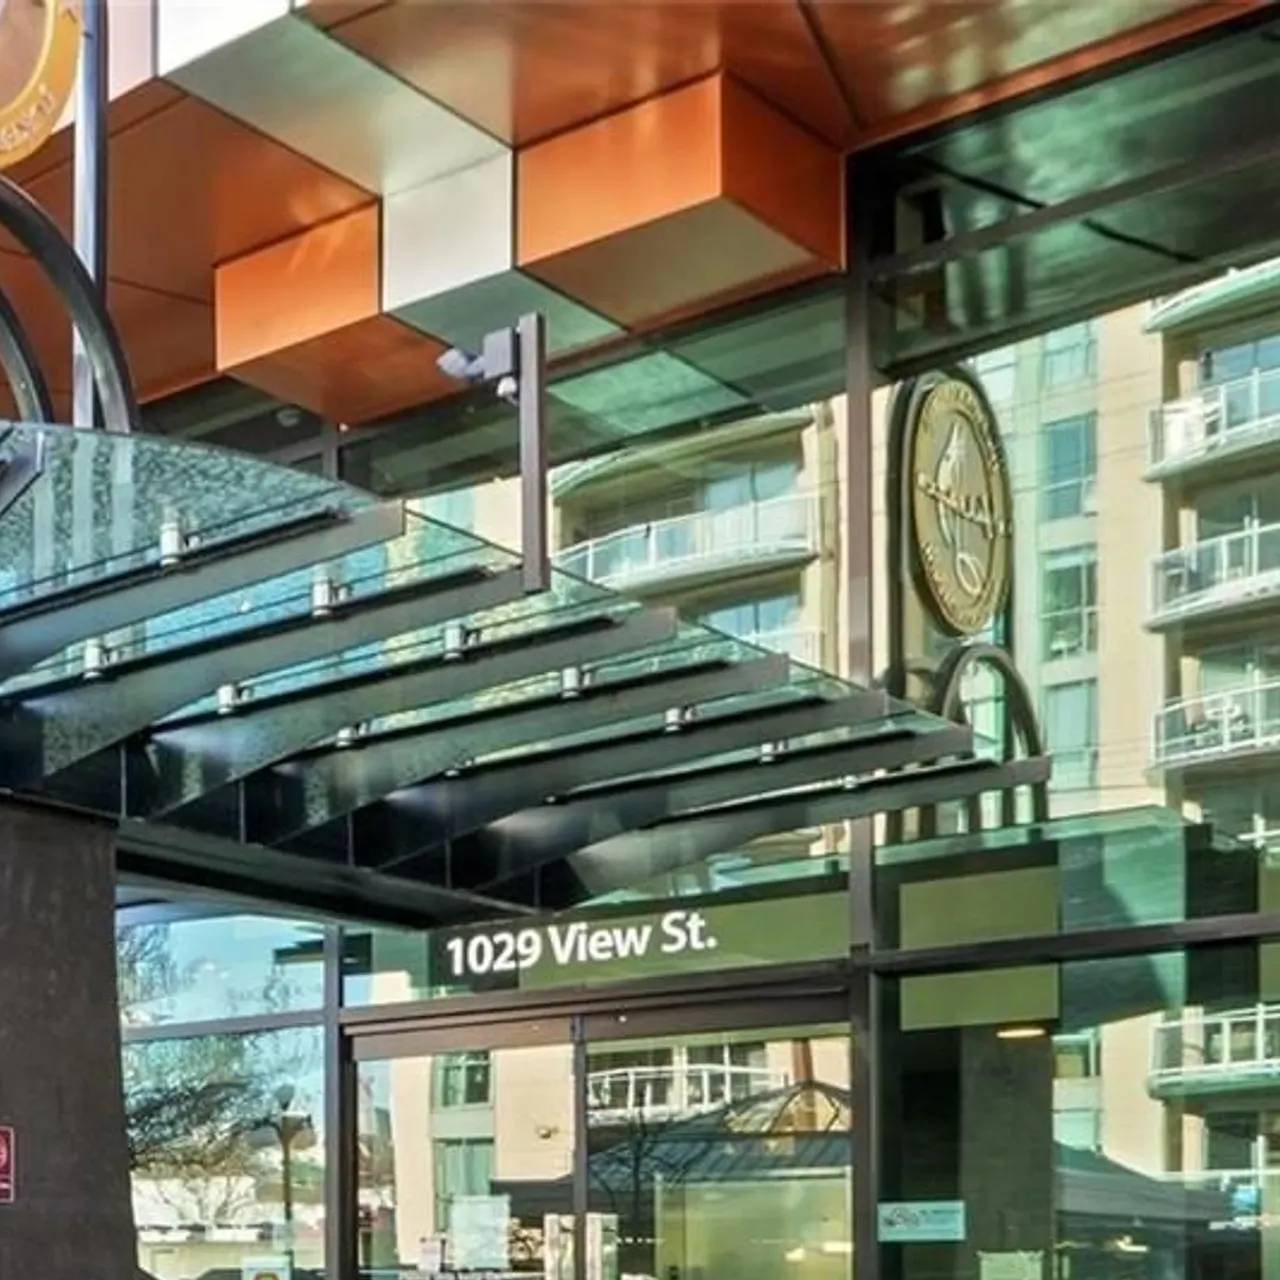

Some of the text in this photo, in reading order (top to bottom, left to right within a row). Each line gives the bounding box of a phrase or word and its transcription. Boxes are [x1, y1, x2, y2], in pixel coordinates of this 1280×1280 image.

[446, 910, 717, 976] 1029 View St.
